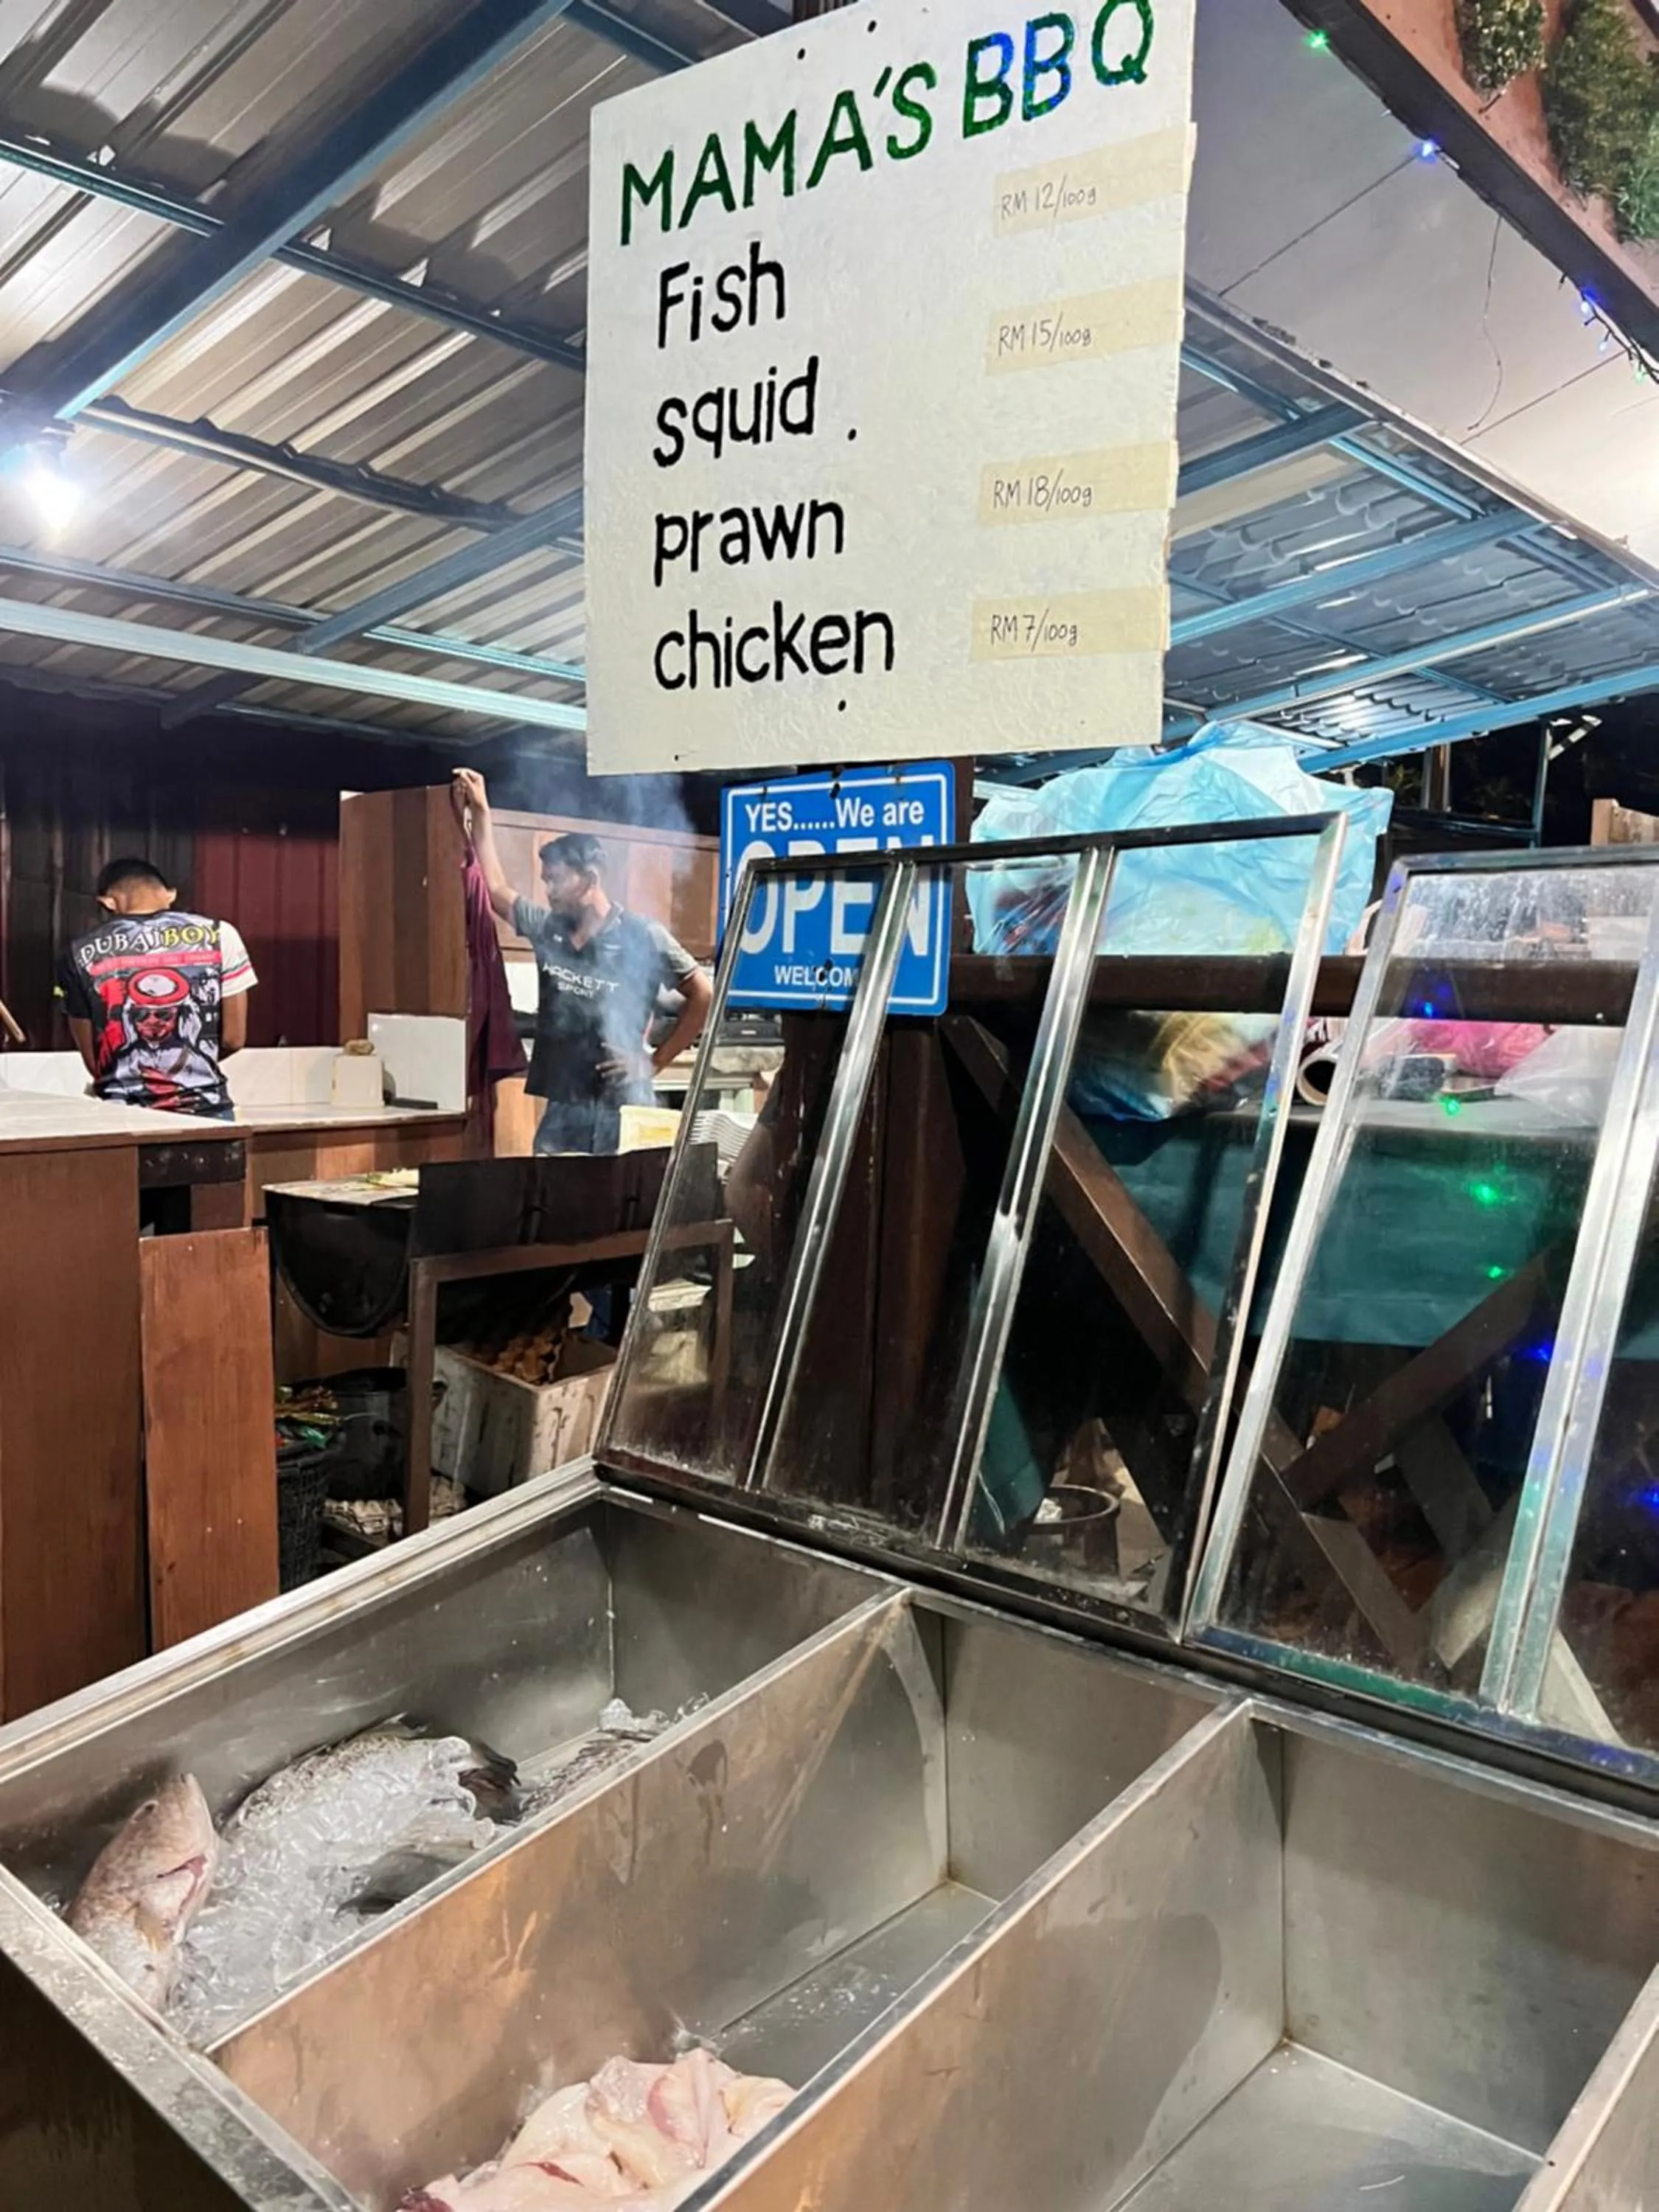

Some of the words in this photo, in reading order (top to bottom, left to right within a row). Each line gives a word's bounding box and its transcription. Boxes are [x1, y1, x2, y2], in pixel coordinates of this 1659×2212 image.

[621, 62, 937, 247] MAMA'S
[963, 0, 1155, 139] BBQ
[1001, 189, 1027, 220] RM
[1035, 173, 1096, 218] 12/100g
[658, 242, 786, 349] Fish
[998, 324, 1025, 358] RM
[1032, 310, 1091, 352] 15/100g
[653, 356, 819, 467] squid
[993, 479, 1020, 508] RM
[1028, 468, 1092, 512] 18/100g
[654, 499, 845, 588] prawn
[654, 600, 895, 691] chicken
[991, 614, 1018, 645] RM
[1022, 608, 1077, 653] 7/100g
[882, 799, 925, 826] are
[773, 964, 859, 987] WELCOM
